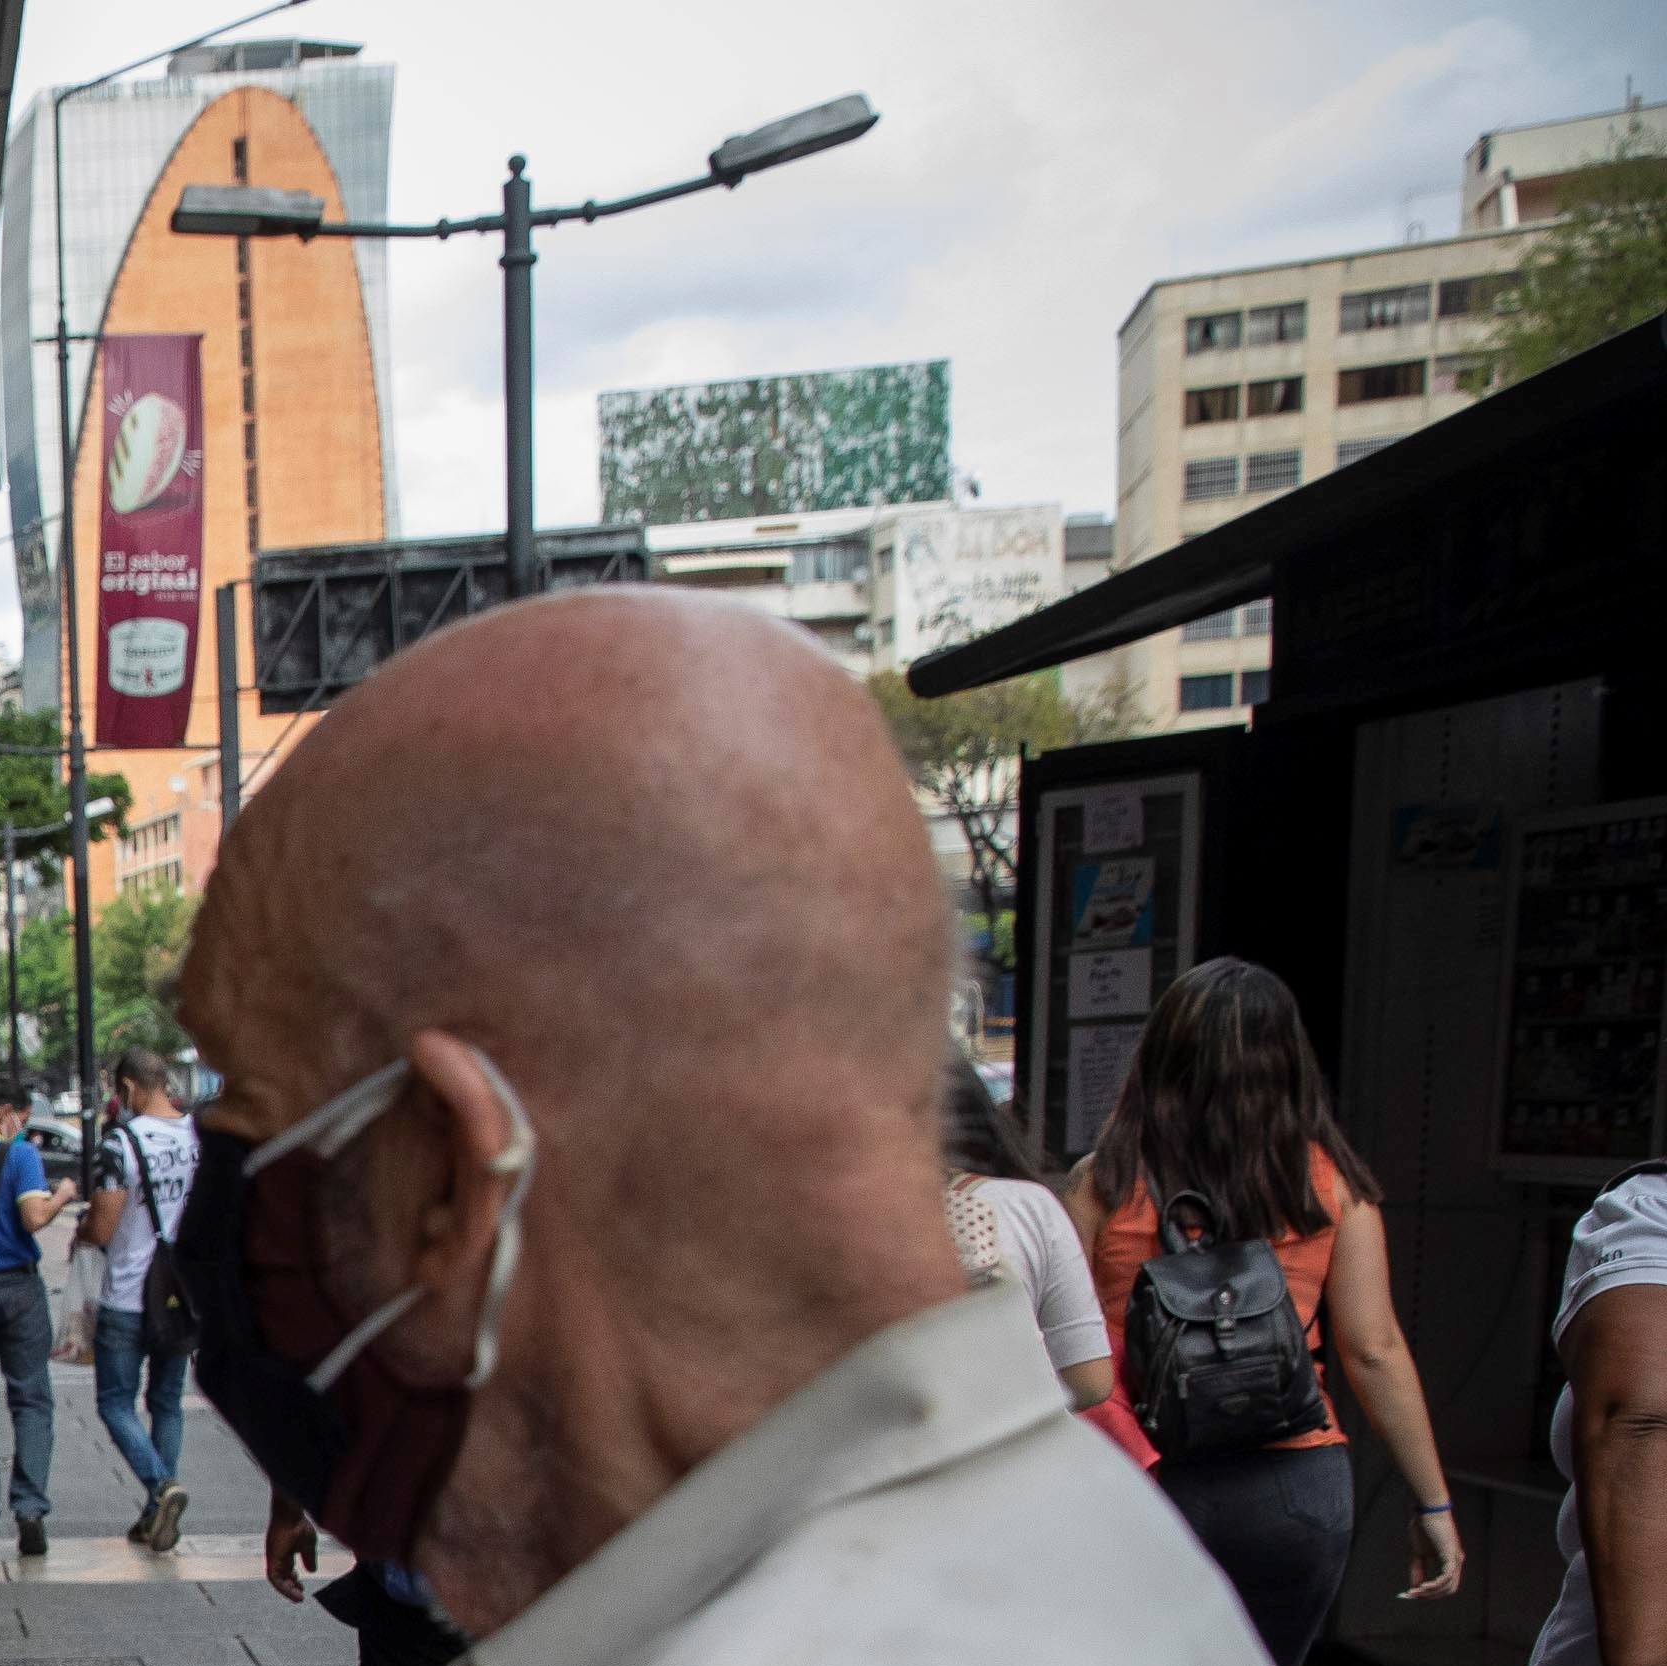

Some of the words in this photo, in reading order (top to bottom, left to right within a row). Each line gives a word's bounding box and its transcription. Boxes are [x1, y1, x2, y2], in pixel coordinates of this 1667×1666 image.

[103, 550, 126, 572] El
[129, 549, 188, 572] sabor
[100, 567, 199, 596] original
